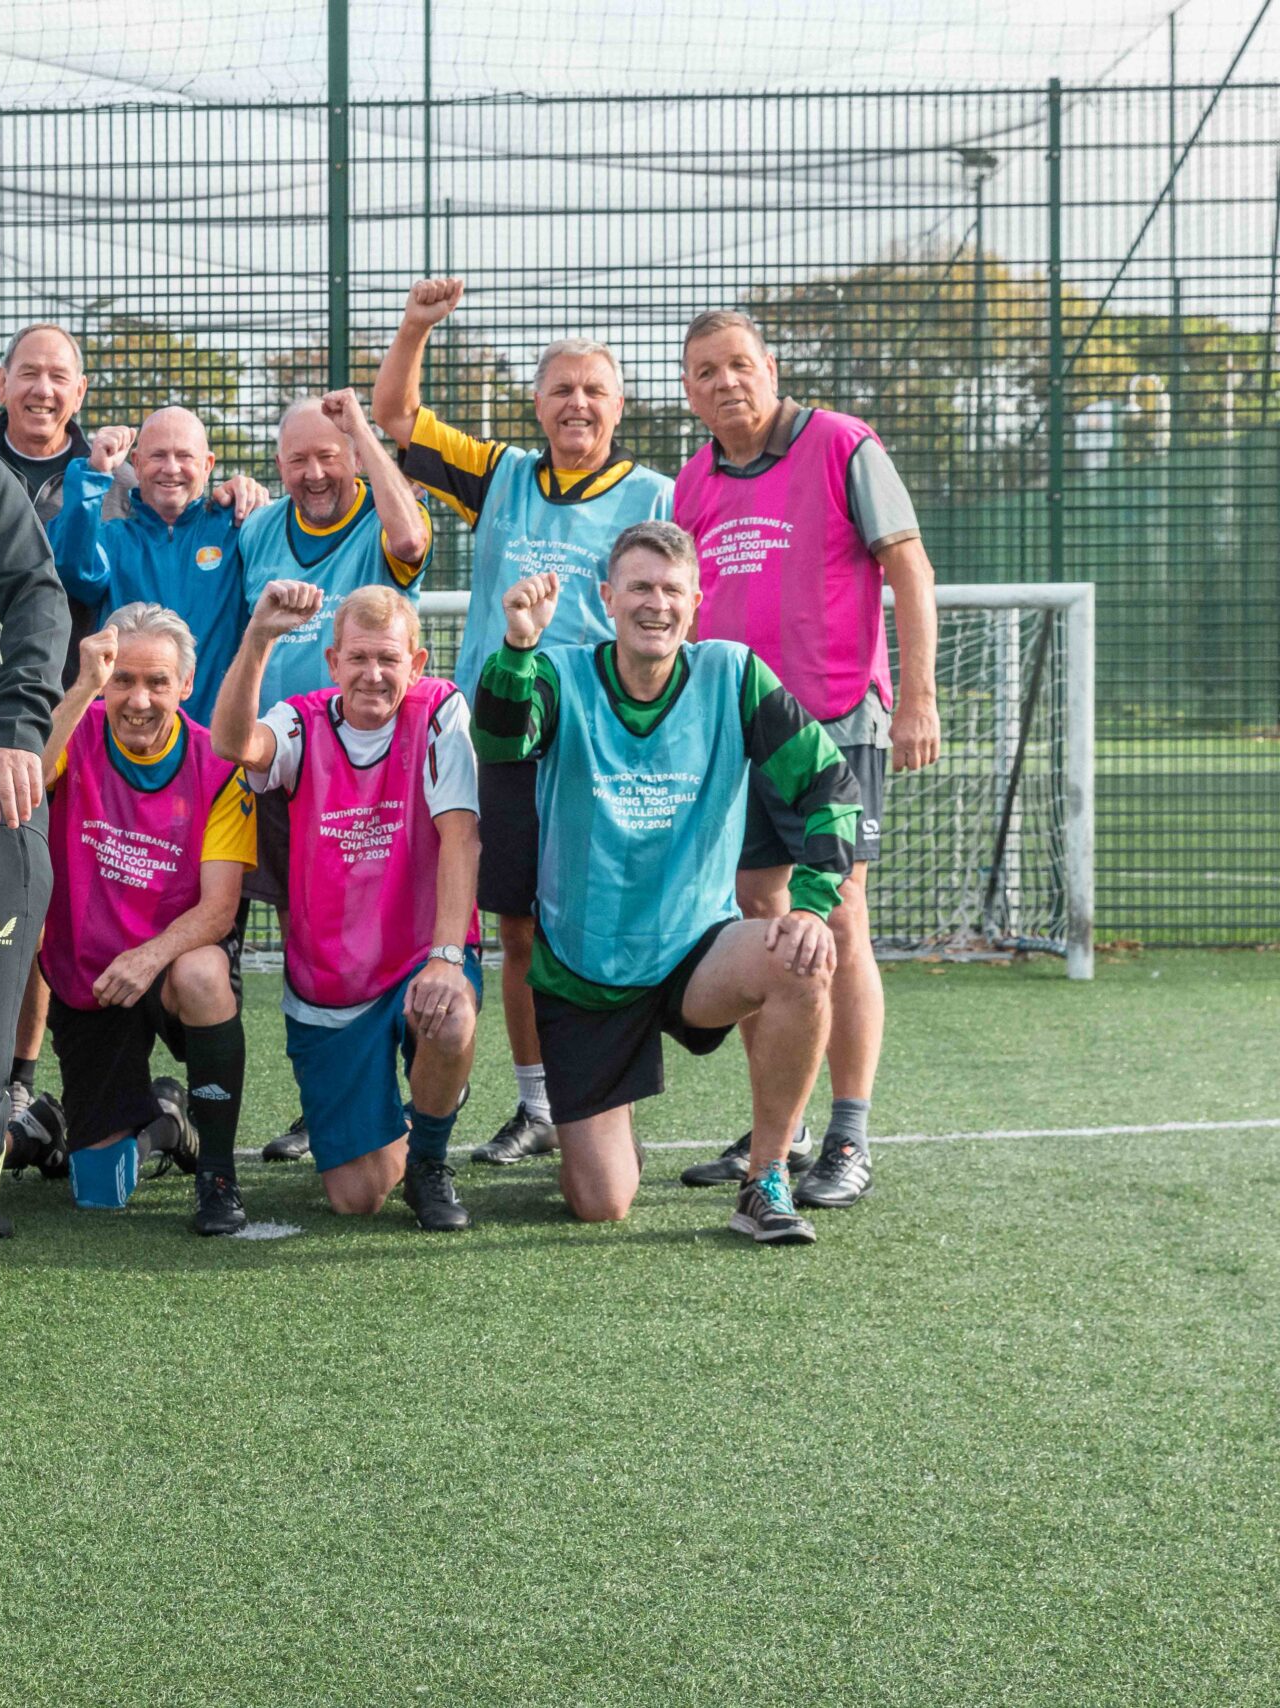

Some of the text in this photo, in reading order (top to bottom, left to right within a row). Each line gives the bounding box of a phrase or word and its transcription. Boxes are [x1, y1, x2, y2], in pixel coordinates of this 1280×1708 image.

[781, 522, 793, 532] FC
[734, 529, 760, 540] HOUR
[739, 539, 790, 550] FOOTBALL
[544, 563, 593, 578] FOOTBALL
[619, 786, 669, 796] 24 HOUR
[644, 792, 696, 806] FOOTBALL
[321, 807, 374, 821] SOUTHPORT
[613, 805, 677, 817] CHALLENGE
[352, 821, 364, 829] 24
[117, 843, 148, 857] HOUR
[124, 831, 170, 849] VETERANS
[170, 844, 183, 856] FC
[96, 852, 154, 879] CHALLENGE
[123, 856, 177, 872] FOOTBALL
